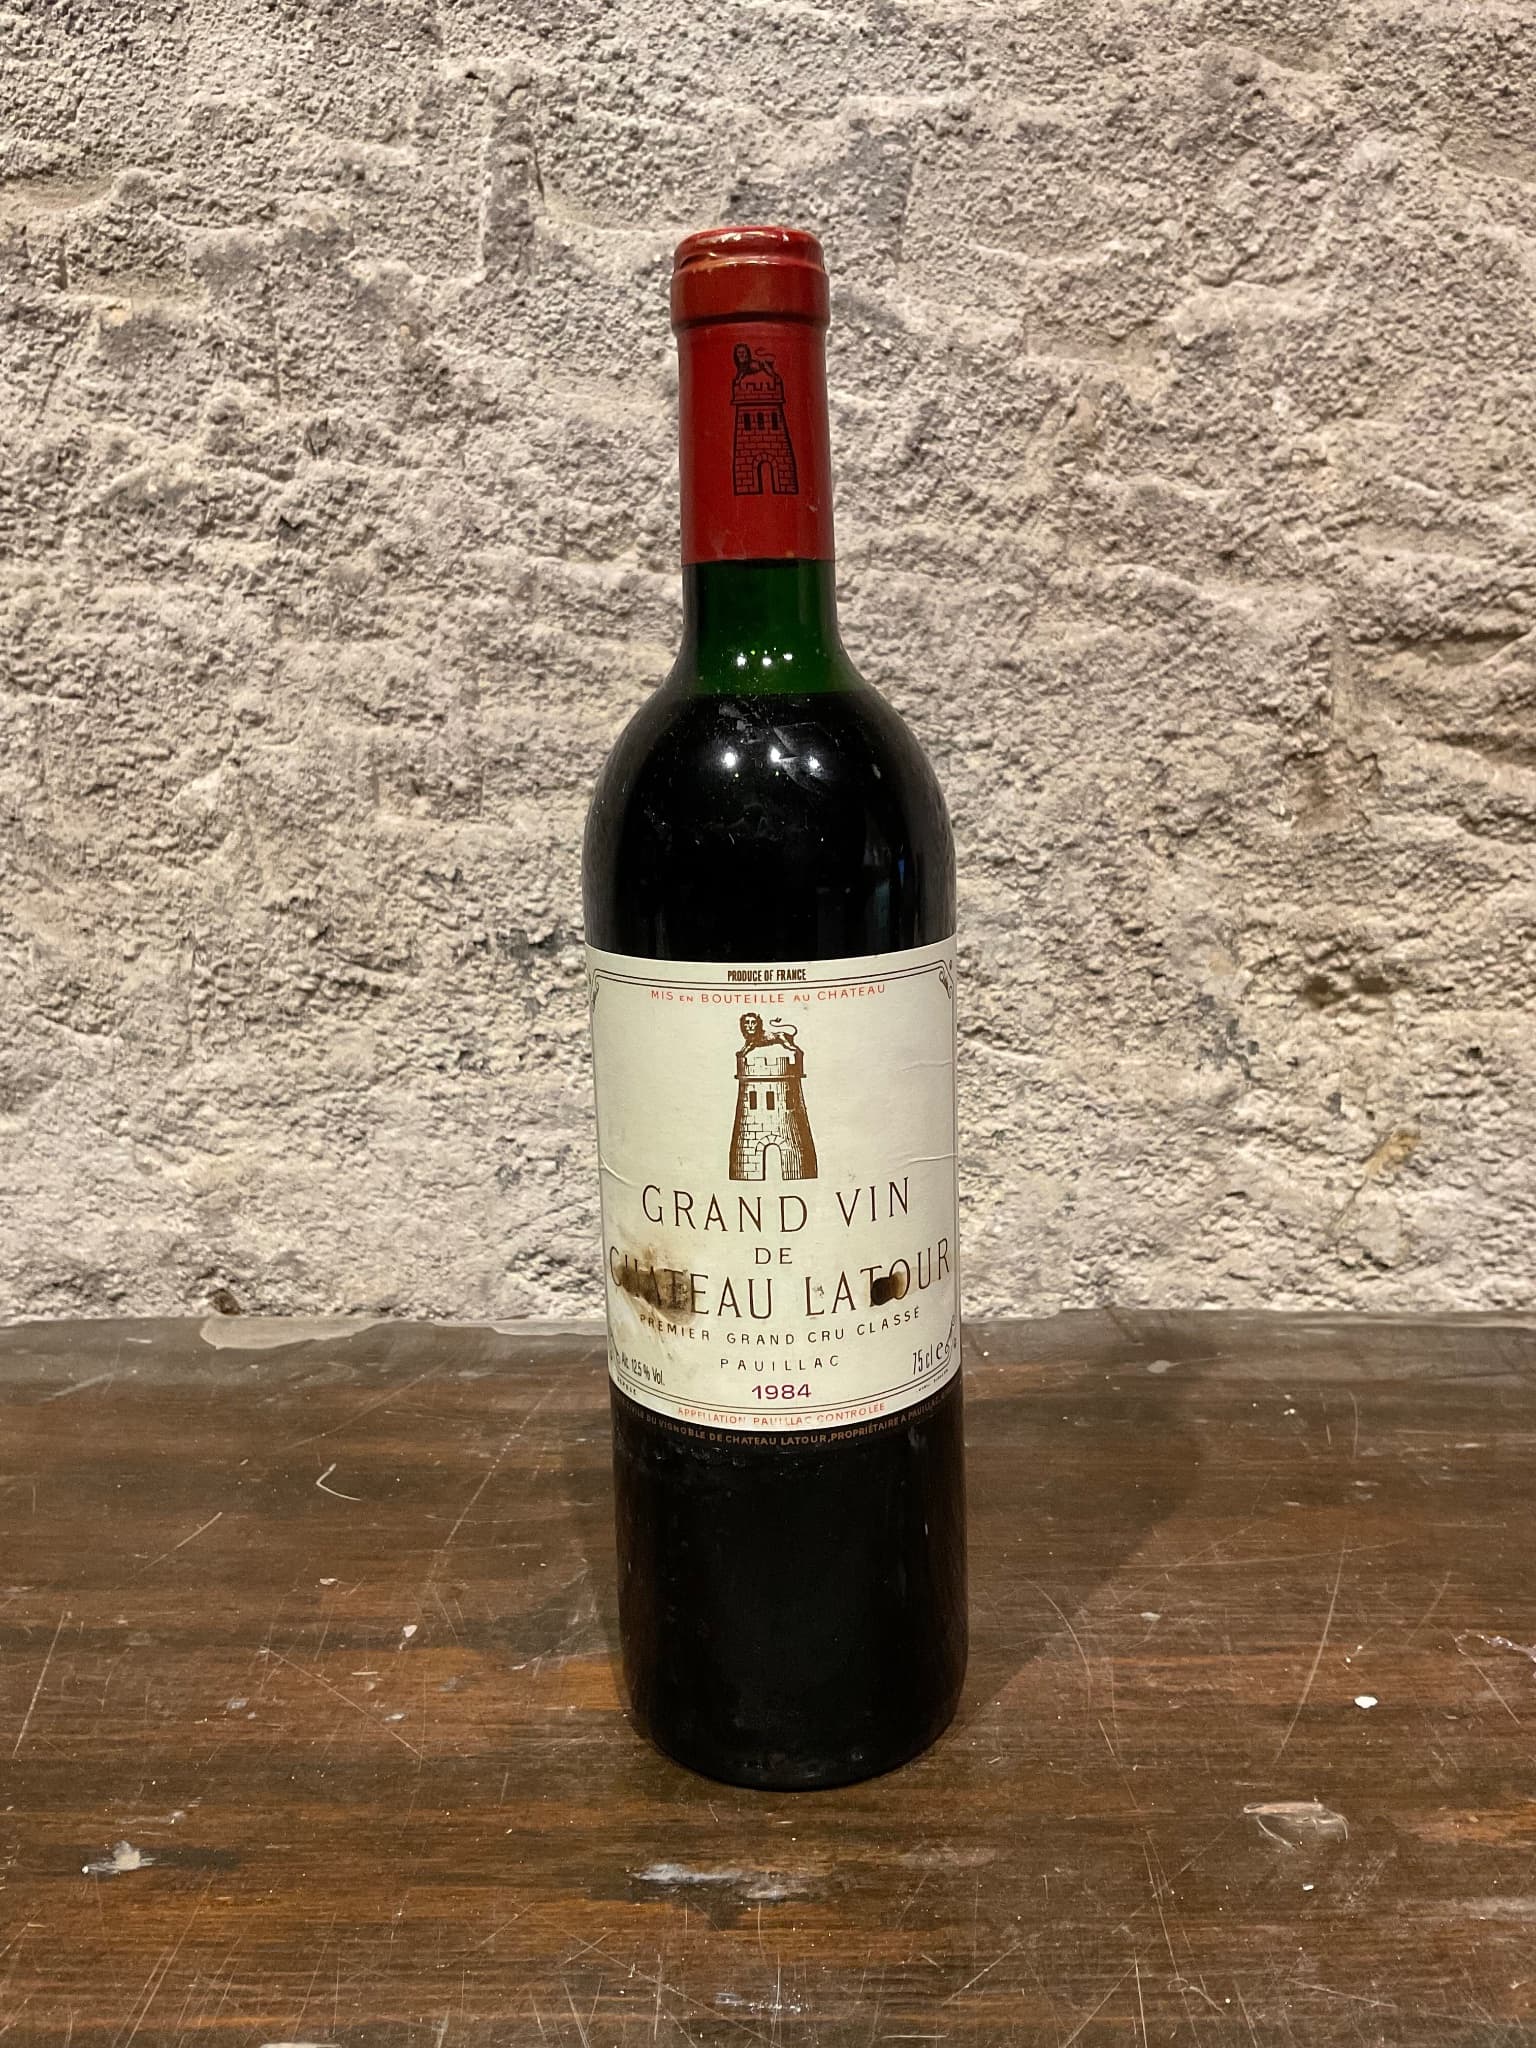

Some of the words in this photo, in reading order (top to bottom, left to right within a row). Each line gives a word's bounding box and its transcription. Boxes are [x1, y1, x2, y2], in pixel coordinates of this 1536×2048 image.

[728, 968, 763, 982] PRODUCE
[764, 969, 774, 981] OF
[776, 967, 807, 981] FRANCE
[650, 989, 674, 1001] MIS
[679, 993, 693, 1003] EN
[701, 992, 785, 1004] BOUTEILLE
[793, 993, 811, 1003] AU
[817, 983, 886, 1001] CHATEAU
[642, 1184, 808, 1233] GRAND
[836, 1176, 909, 1227] VIN
[755, 1247, 793, 1265] DE
[804, 1237, 950, 1317] LATOUR
[639, 1314, 710, 1341] PREMIER
[727, 1332, 795, 1346] GRAND
[807, 1328, 844, 1343] CRU
[720, 1355, 839, 1372] PAUILLAC
[912, 1348, 923, 1377] 75
[751, 1384, 812, 1400] 1984
[658, 1419, 706, 1440] VIGNOBLE
[708, 1432, 723, 1442] DE
[725, 1435, 778, 1446] CHATEAU
